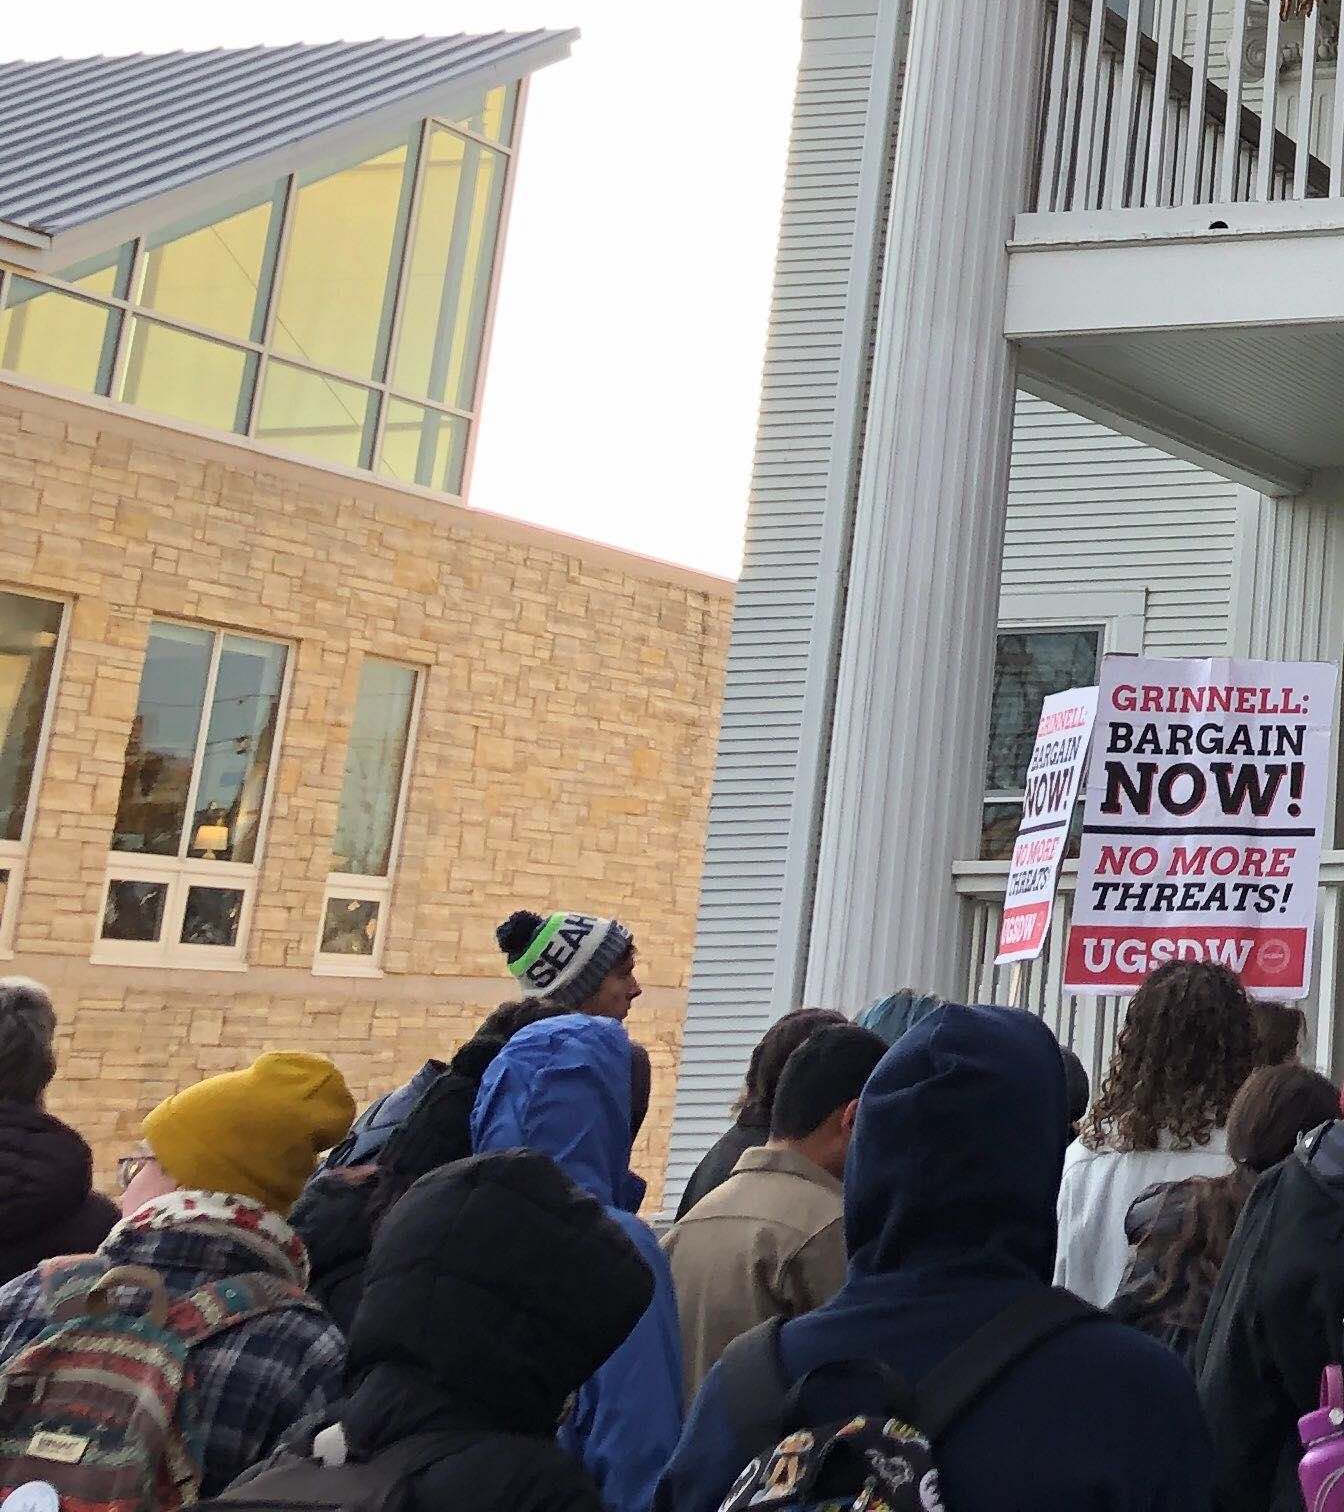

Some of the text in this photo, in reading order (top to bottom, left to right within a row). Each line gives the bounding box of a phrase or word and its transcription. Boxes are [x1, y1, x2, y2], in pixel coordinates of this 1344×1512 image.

[1111, 684, 1309, 715] GRINNELL:
[1031, 735, 1082, 772] BARGAIN
[1106, 721, 1306, 756] BARGAIN
[1026, 766, 1074, 818] NOW!
[1100, 761, 1305, 818] NOW!
[1094, 845, 1297, 878] NO MORE
[1092, 882, 1293, 914] THREATS!
